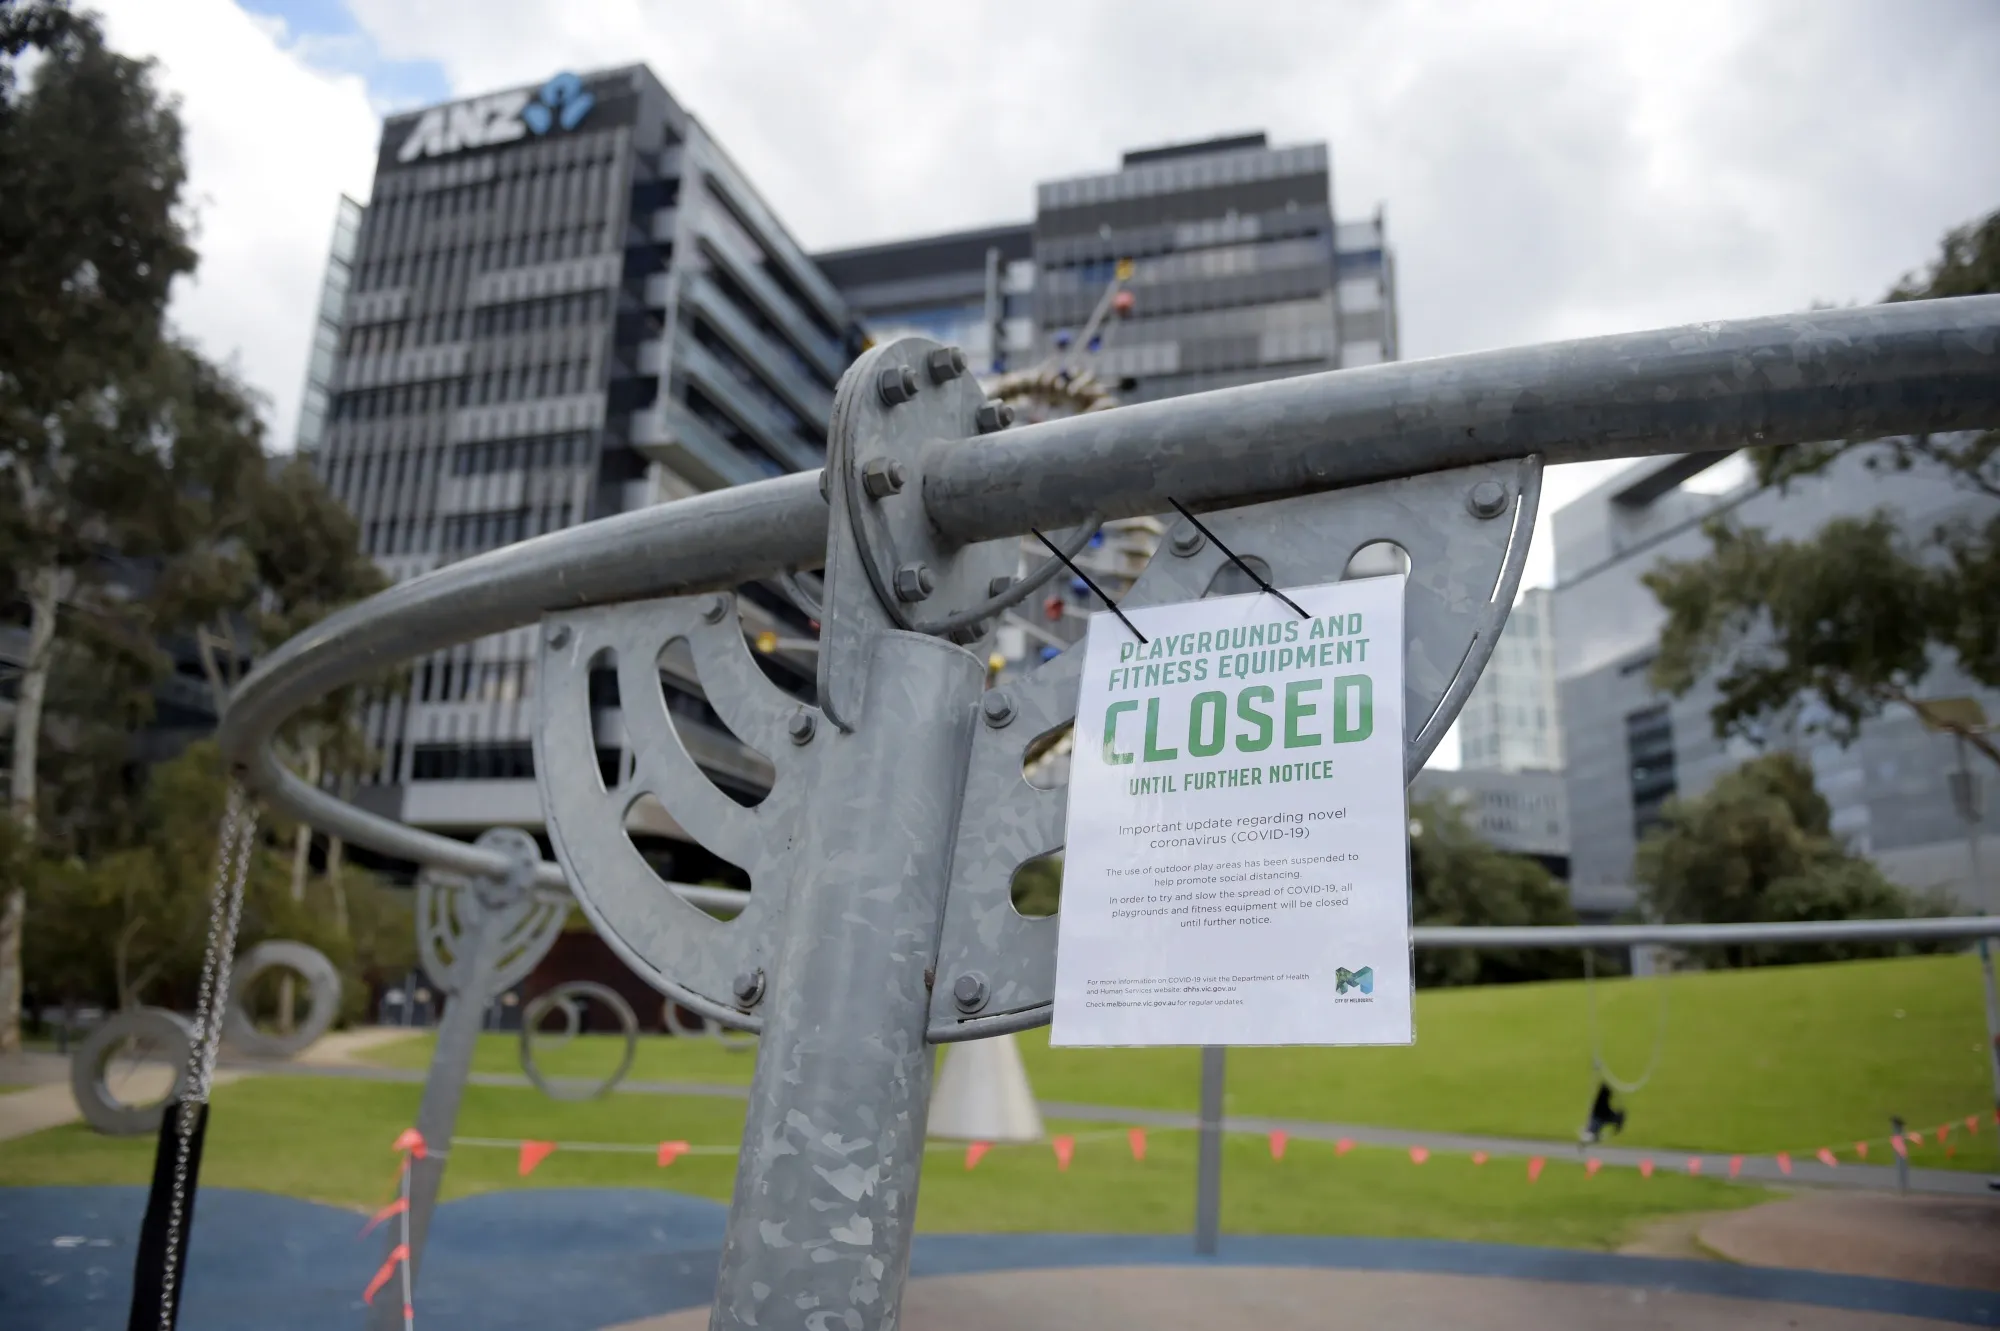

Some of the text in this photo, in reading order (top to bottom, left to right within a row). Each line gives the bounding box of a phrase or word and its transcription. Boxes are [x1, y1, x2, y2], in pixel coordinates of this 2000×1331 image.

[397, 90, 530, 163] ANZ
[1119, 613, 1363, 663] PLAYGROUNDS AND
[1108, 638, 1370, 691] FITNESS EQUIPMENT
[1102, 673, 1374, 766] CLOSED
[1129, 760, 1334, 796] UNTIL FURTHER NOTICE
[1119, 808, 1347, 837] Important update regarding novel
[1149, 827, 1310, 849] coronavirus (COVID-19)
[1106, 853, 1359, 877] The use of outdoor play areas has been suspended to
[1154, 870, 1302, 888] help promote social distancing.
[1109, 883, 1353, 904] In order to try and slow the spread of COVID-19, all
[1111, 897, 1349, 918] playgrounds and fitness equipment will be closed
[1180, 915, 1272, 928] until further notice.
[1168, 976, 1201, 984] COVID-19
[1231, 975, 1275, 983] Department
[1106, 1000, 1177, 1008] melbourne.vic.gov.au
[1188, 999, 1213, 1007] regular
[1214, 998, 1243, 1006] updates
